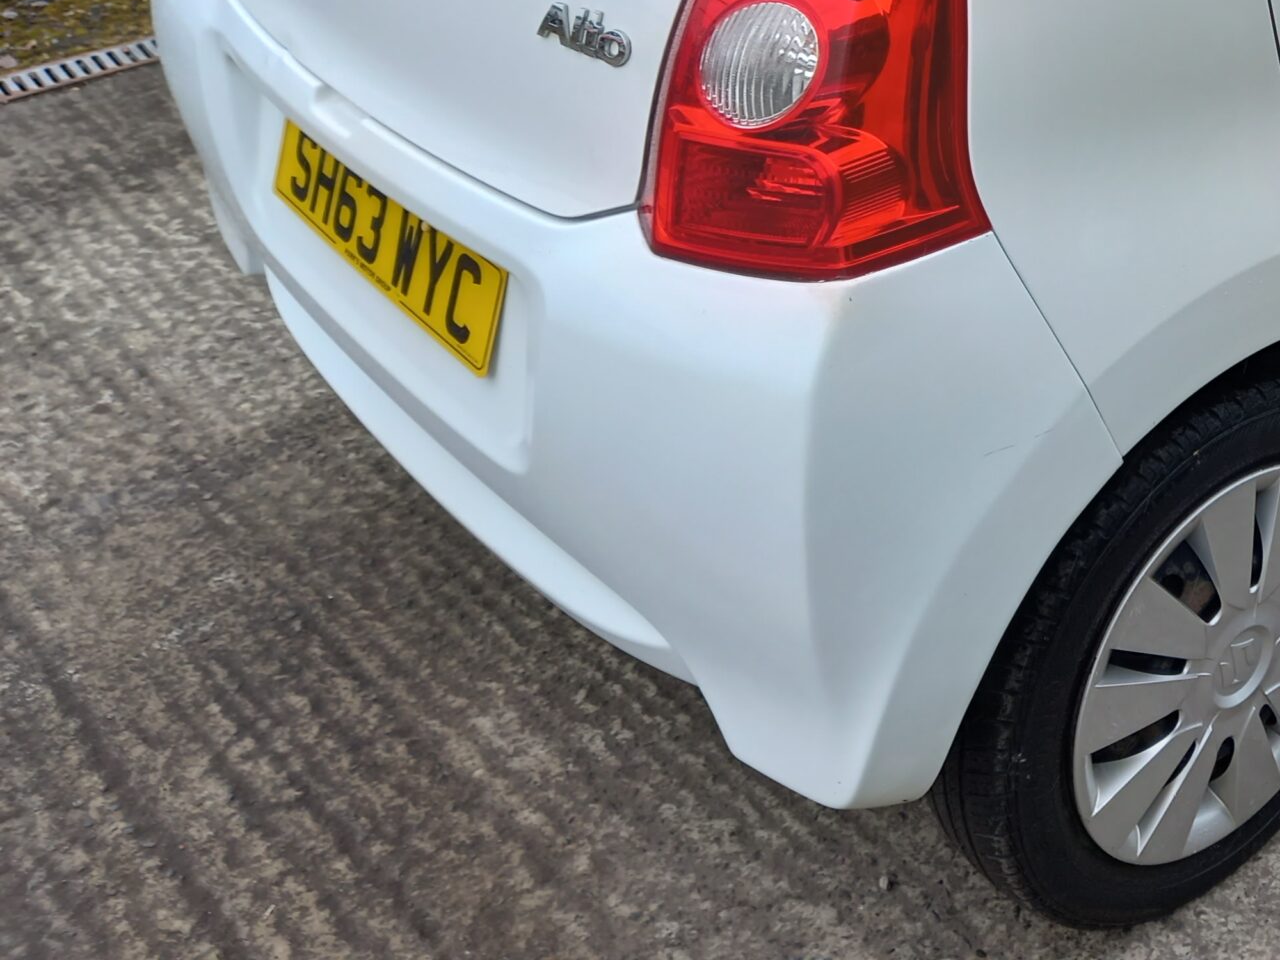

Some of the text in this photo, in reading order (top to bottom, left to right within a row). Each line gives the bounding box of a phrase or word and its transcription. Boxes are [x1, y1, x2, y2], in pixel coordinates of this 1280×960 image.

[536, 1, 632, 68] Alto
[290, 131, 482, 344] SH63 WYC
